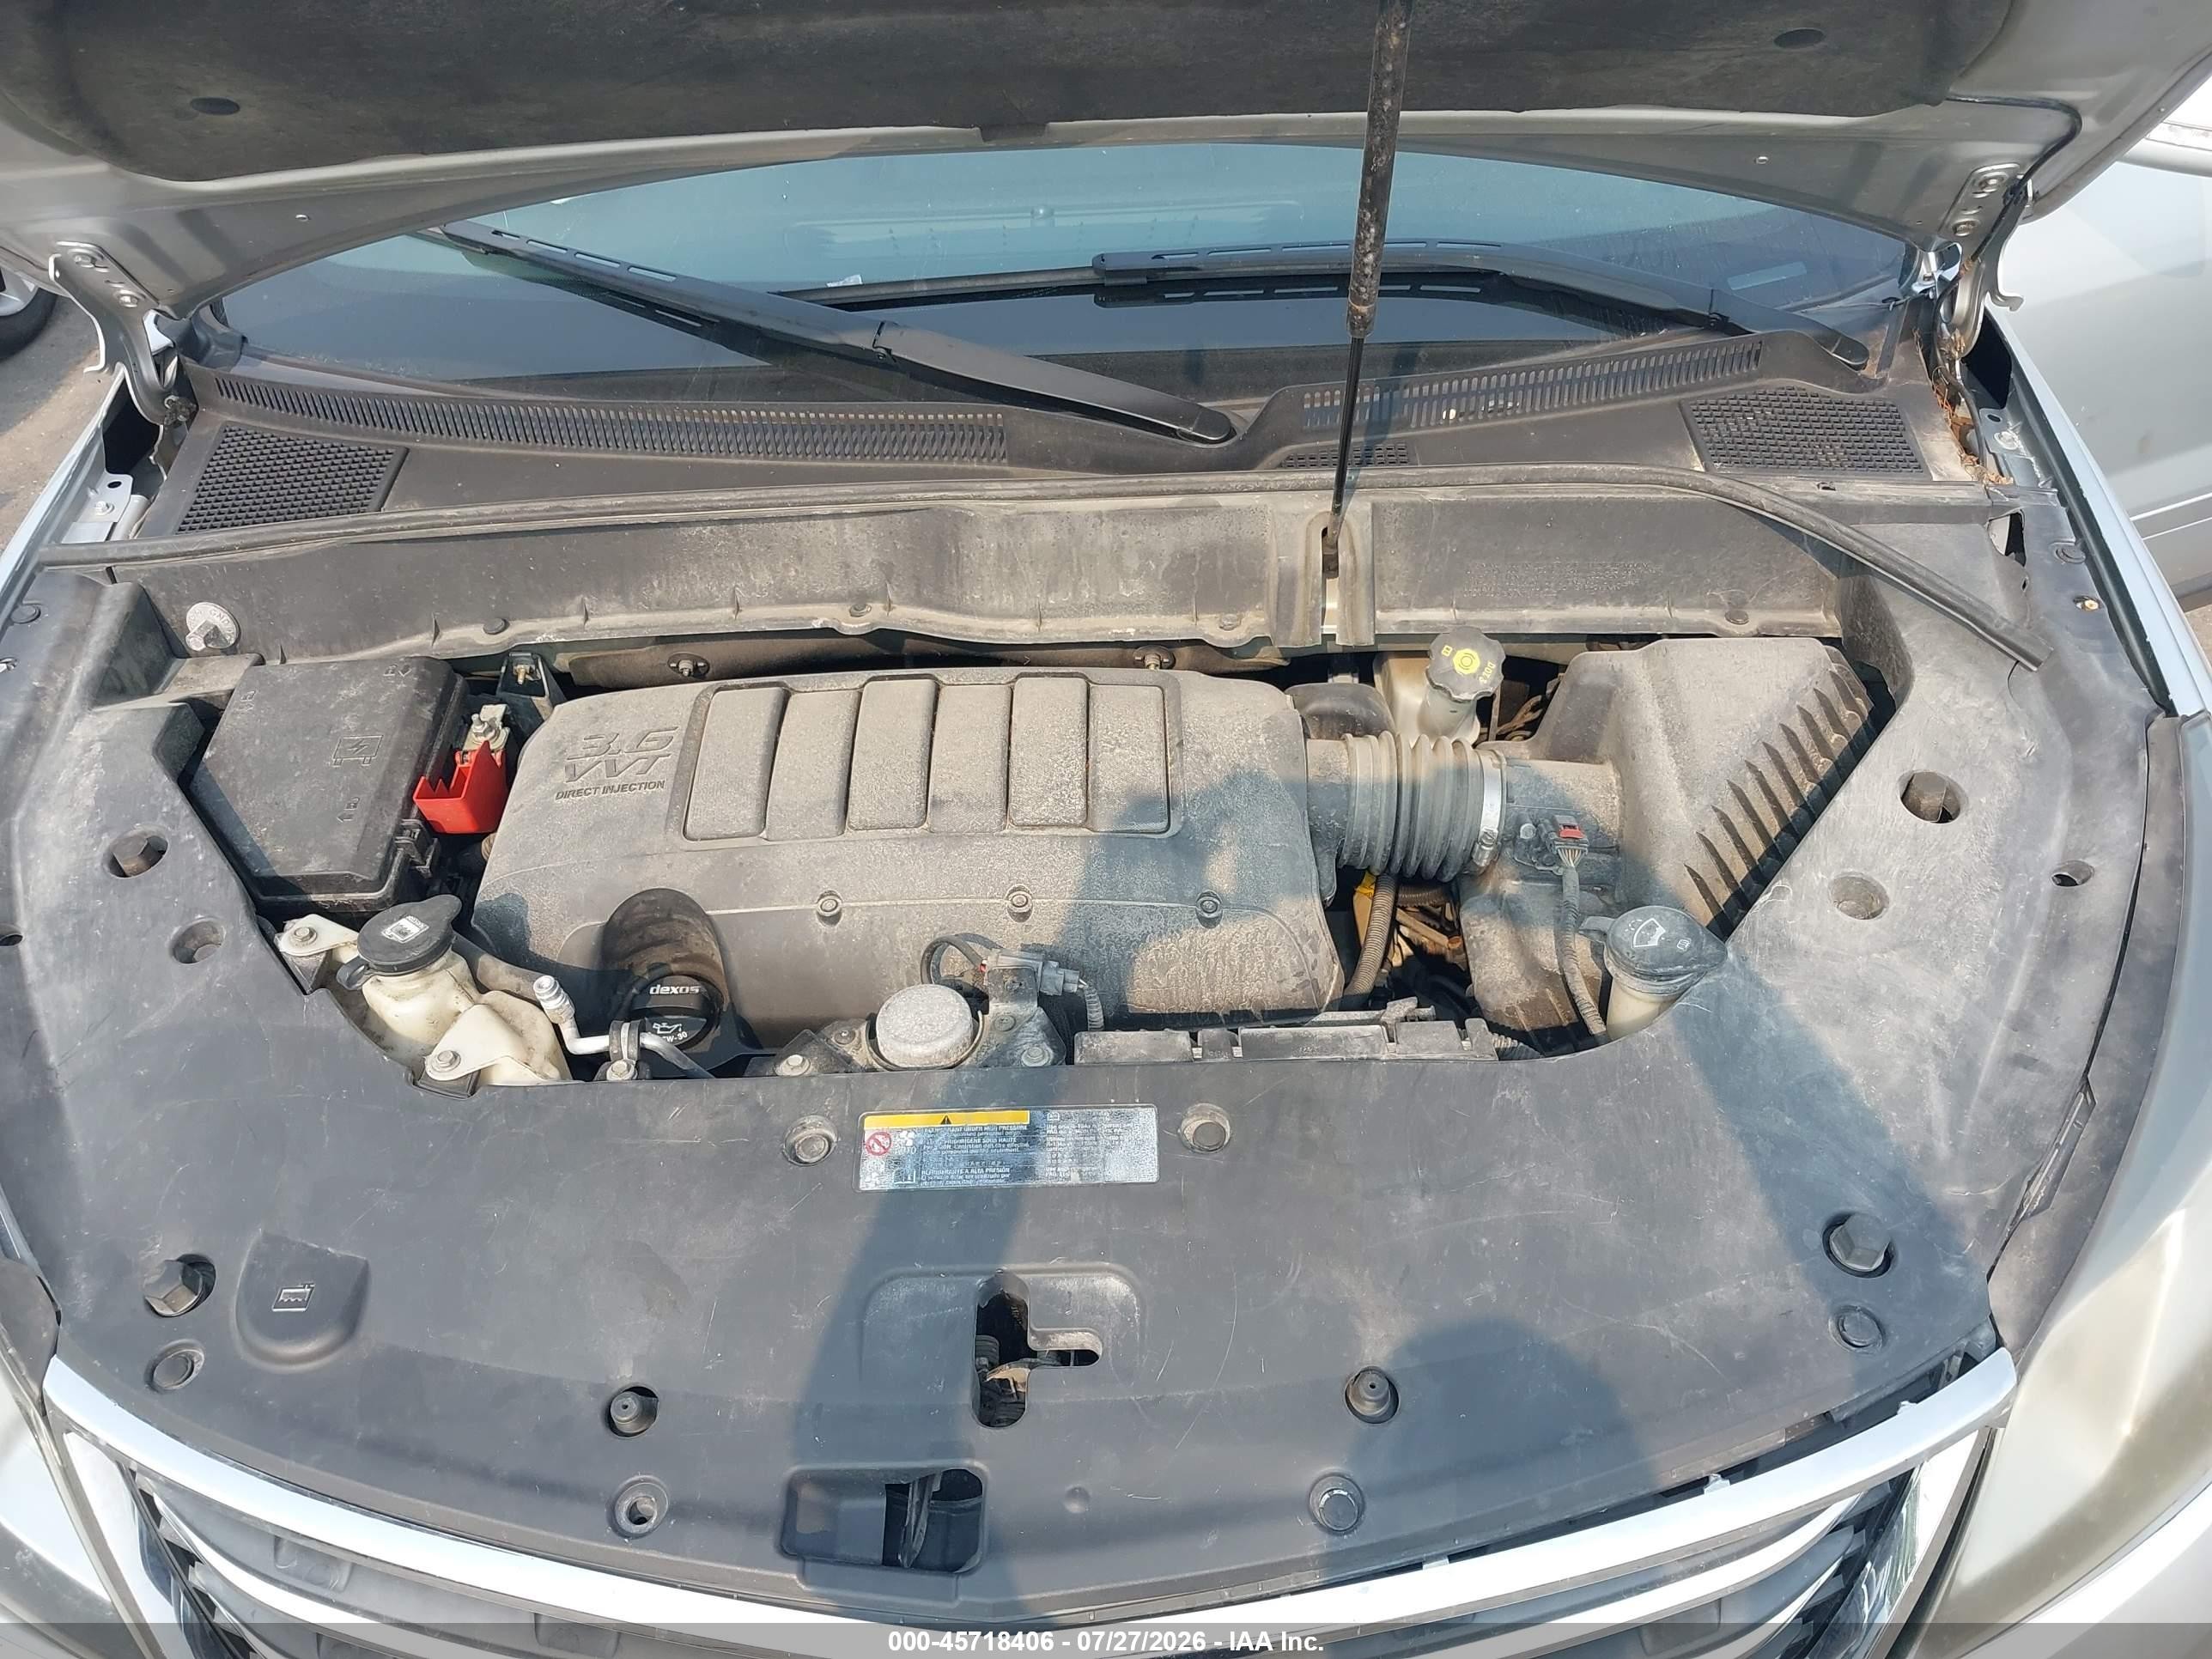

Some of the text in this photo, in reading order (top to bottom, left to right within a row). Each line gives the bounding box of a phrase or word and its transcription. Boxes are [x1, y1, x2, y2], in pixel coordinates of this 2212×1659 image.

[567, 726, 679, 761] 3.6
[563, 752, 672, 783] VVT
[555, 780, 666, 801] DIRECT INJECTION
[649, 983, 702, 994] dexos
[662, 1030, 687, 1042] W-30
